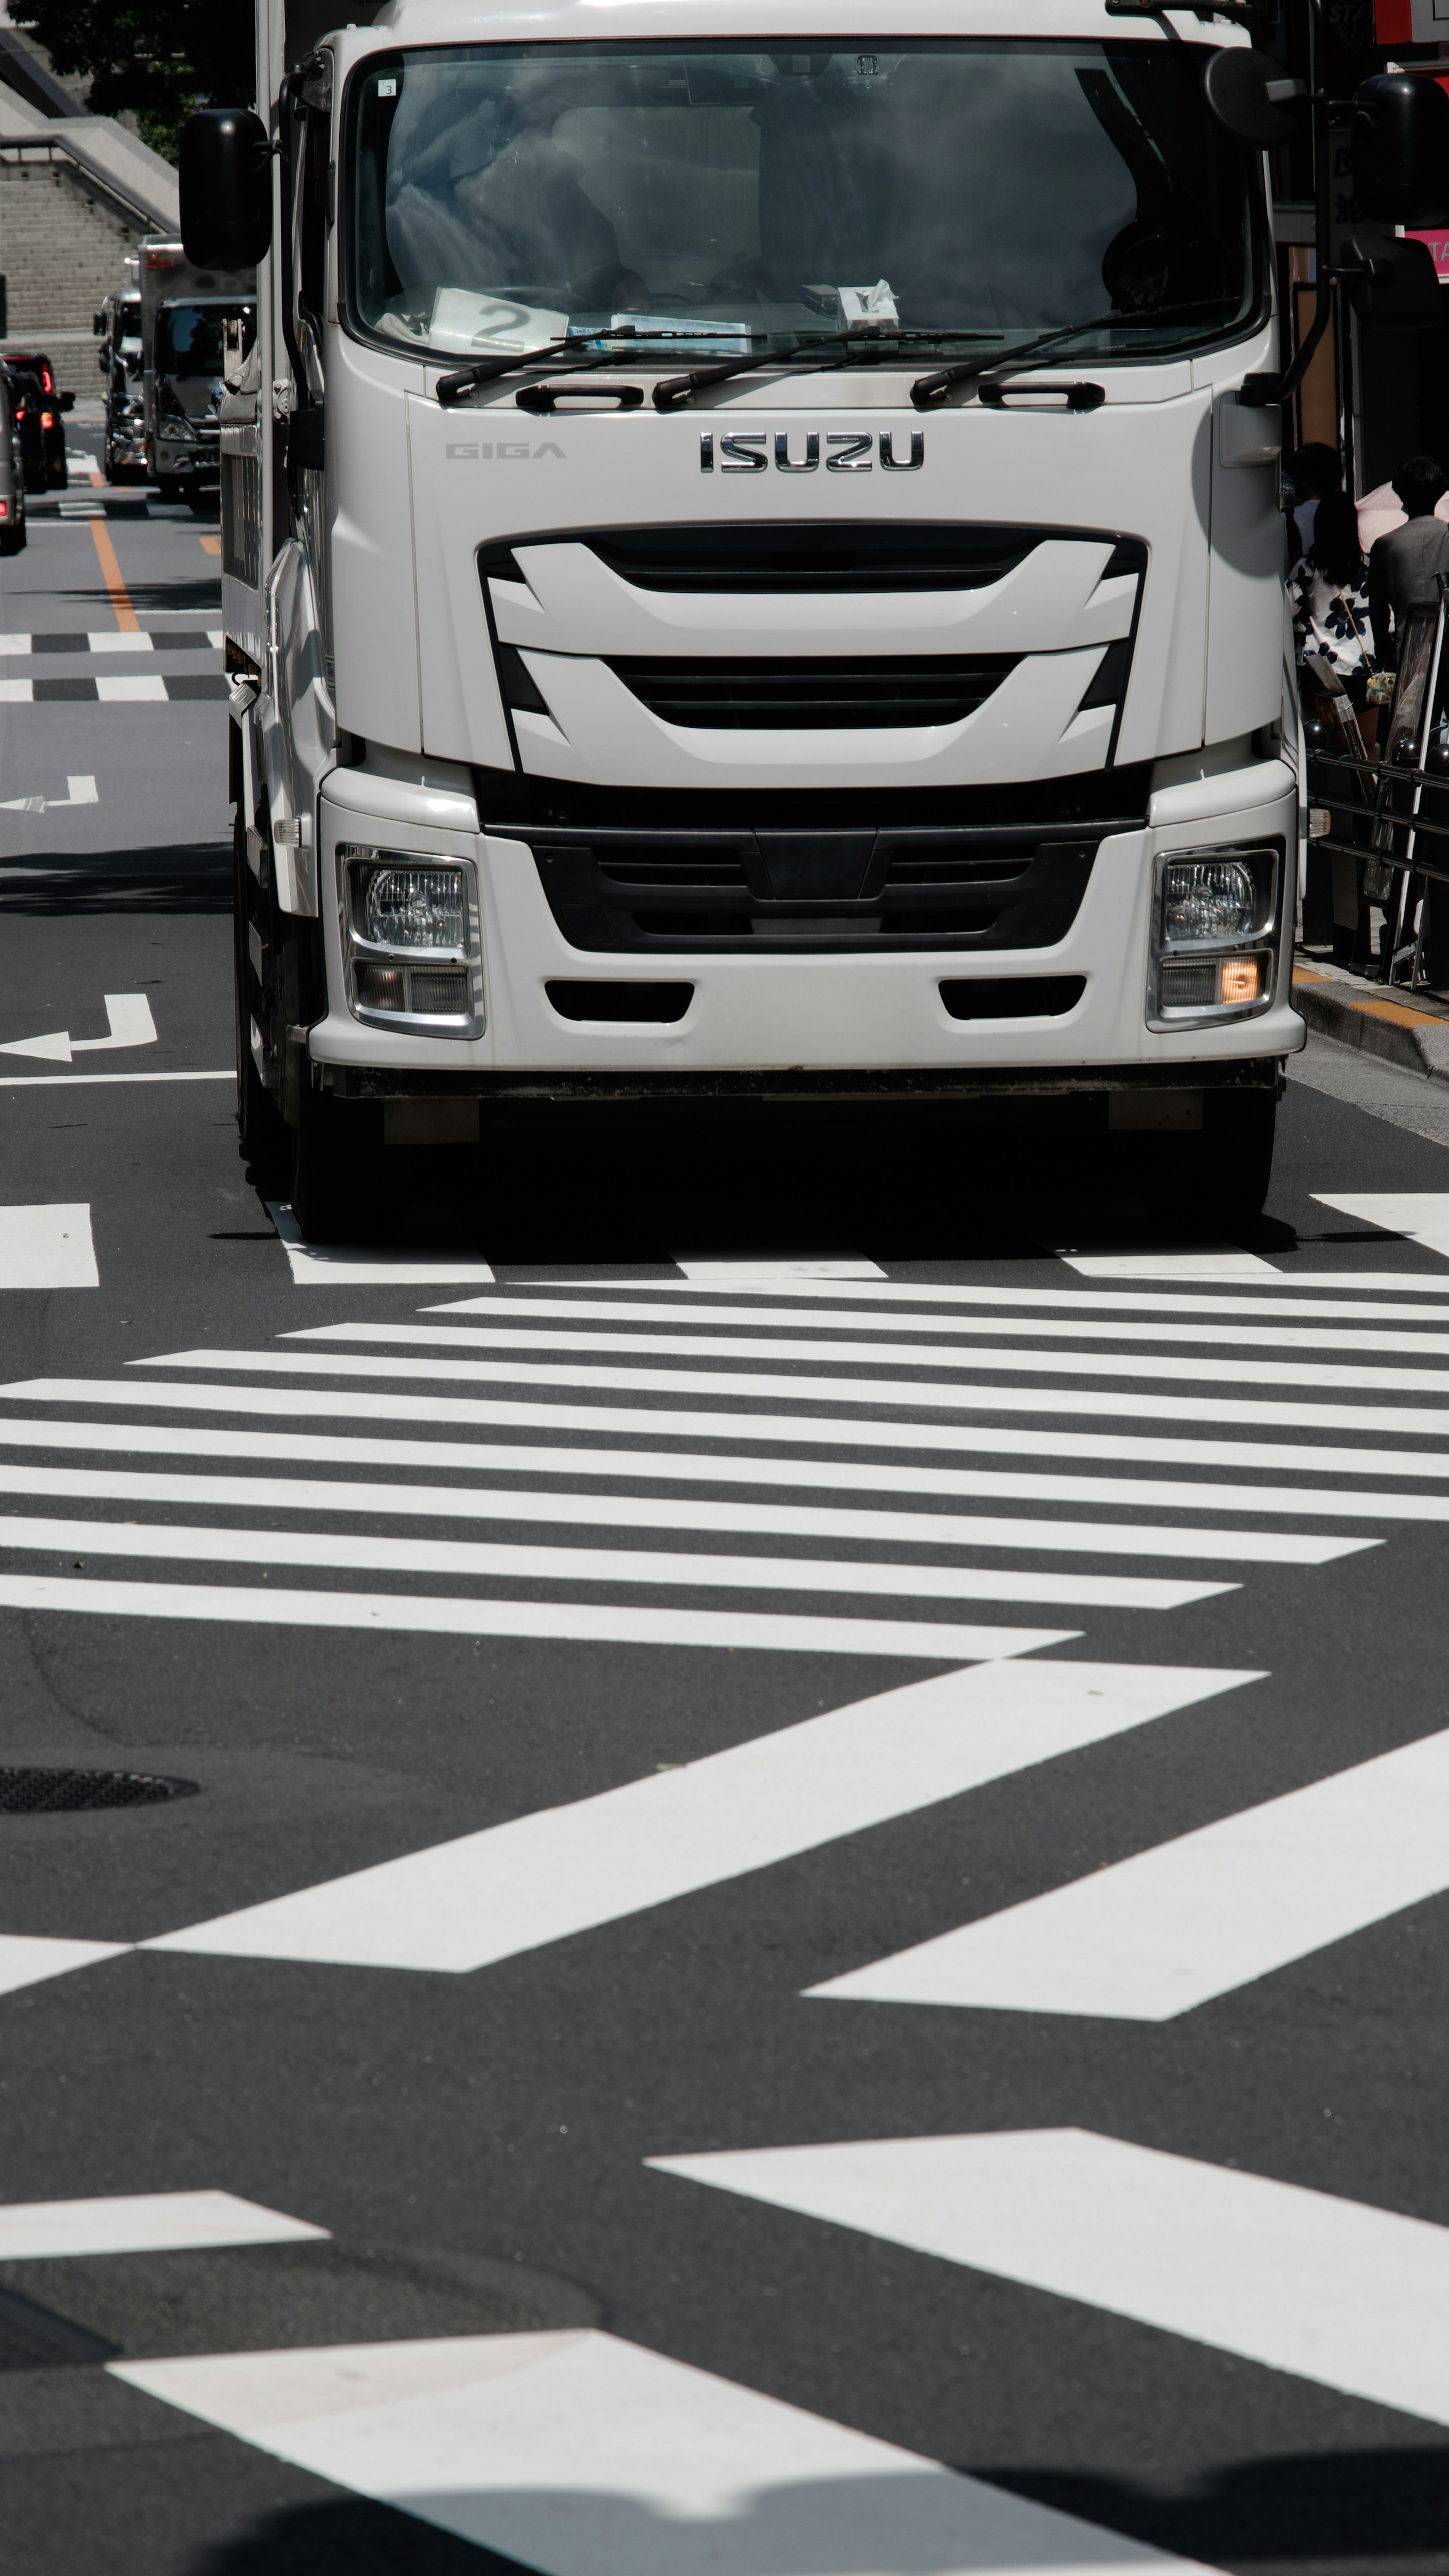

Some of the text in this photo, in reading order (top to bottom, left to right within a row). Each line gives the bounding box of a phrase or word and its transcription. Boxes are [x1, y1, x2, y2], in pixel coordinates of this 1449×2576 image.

[386, 85, 392, 94] 3
[471, 304, 531, 353] 2
[446, 443, 567, 459] GIGA
[700, 430, 924, 473] ISUZU
